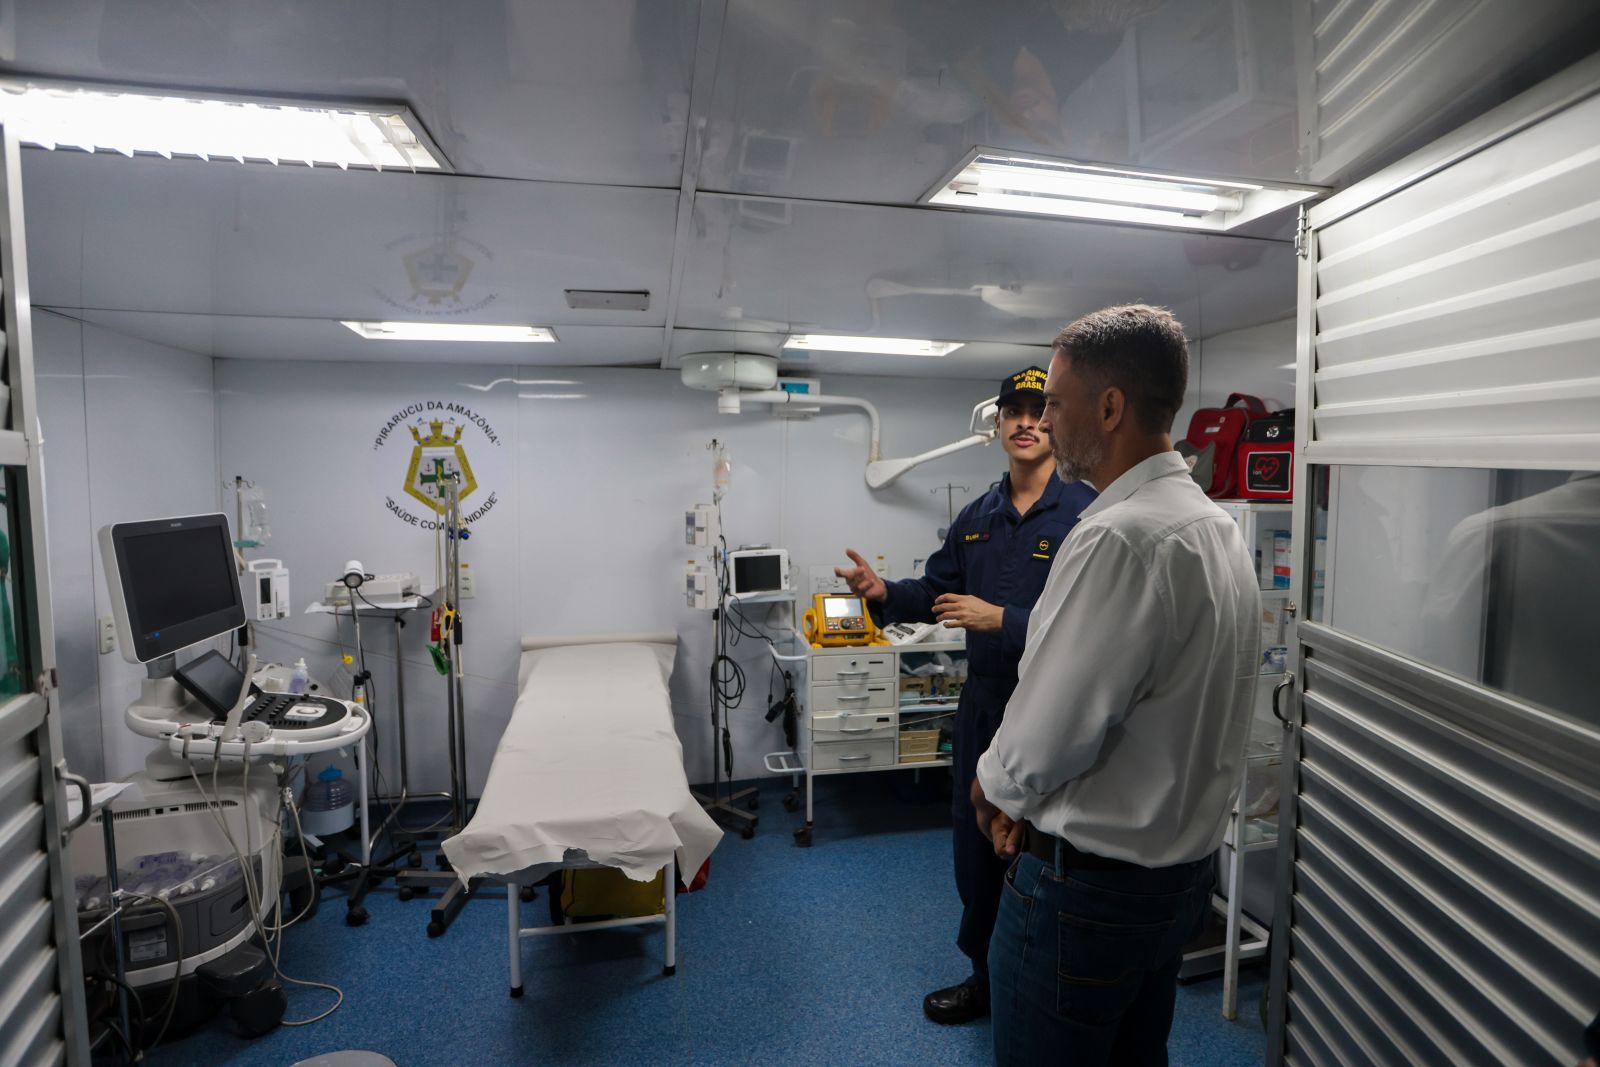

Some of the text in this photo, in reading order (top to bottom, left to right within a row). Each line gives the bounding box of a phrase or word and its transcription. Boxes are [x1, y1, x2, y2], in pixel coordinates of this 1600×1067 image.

[1015, 381, 1043, 390] BRASIL
[427, 401, 444, 410] DA
[420, 491, 498, 530] COMNIDADE"
